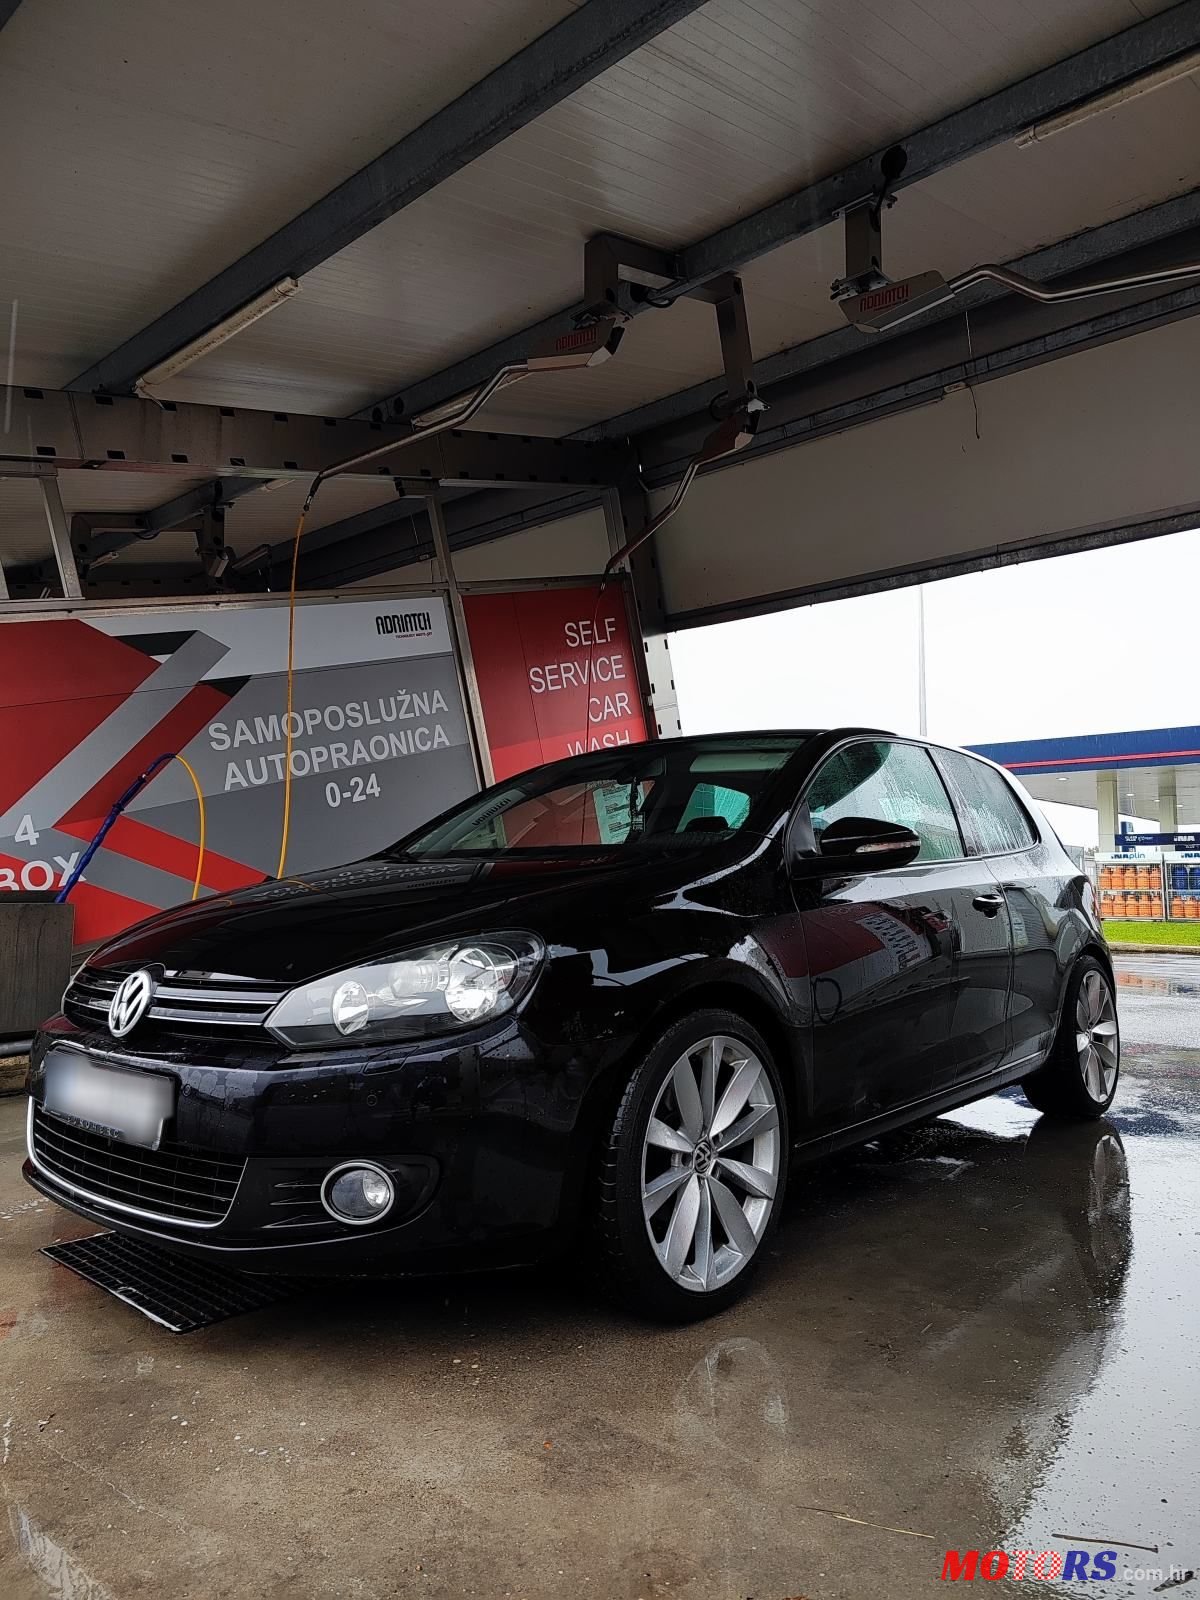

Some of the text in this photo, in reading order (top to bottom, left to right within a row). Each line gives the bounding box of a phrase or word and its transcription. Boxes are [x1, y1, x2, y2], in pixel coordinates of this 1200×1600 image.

[564, 617, 616, 648] SELF
[529, 654, 625, 694] SERVICE
[208, 689, 449, 751] SAMOPOSLUŽNA
[588, 692, 632, 723] CAR
[223, 723, 450, 791] AUTOPRAONICA
[325, 772, 381, 808] 0-24
[15, 814, 40, 846] 4
